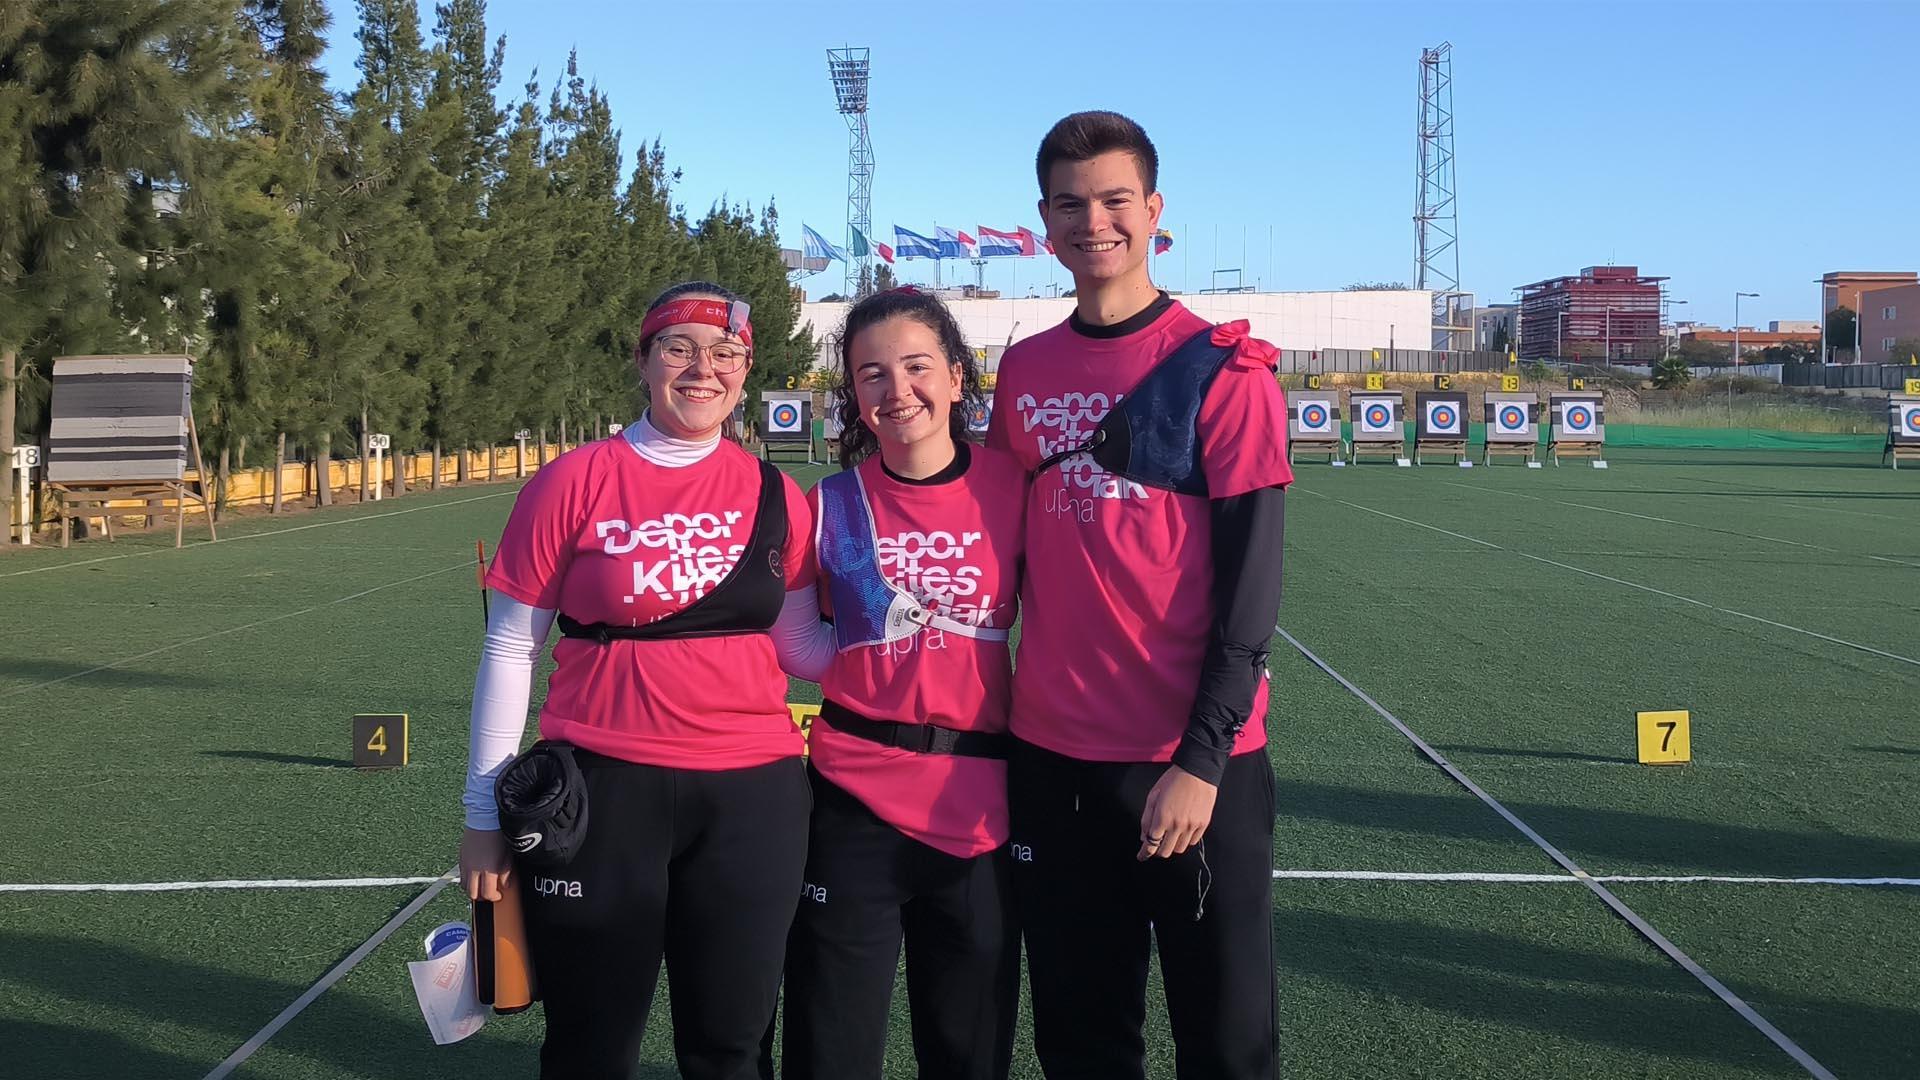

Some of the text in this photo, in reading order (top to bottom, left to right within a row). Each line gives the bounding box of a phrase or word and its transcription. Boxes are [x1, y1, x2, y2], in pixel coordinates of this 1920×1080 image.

[786, 375, 796, 390] 2
[1309, 374, 1321, 389] 10
[1371, 375, 1383, 388] 11
[1438, 375, 1450, 390] 12
[1507, 377, 1518, 390] 13
[1572, 377, 1584, 390] 14
[1016, 392, 1123, 433] Depo
[371, 435, 387, 448] 30
[13, 447, 38, 466] 18
[596, 511, 742, 554] Depor
[367, 724, 387, 757] 4
[1655, 720, 1677, 752] 7
[534, 875, 583, 898] upna
